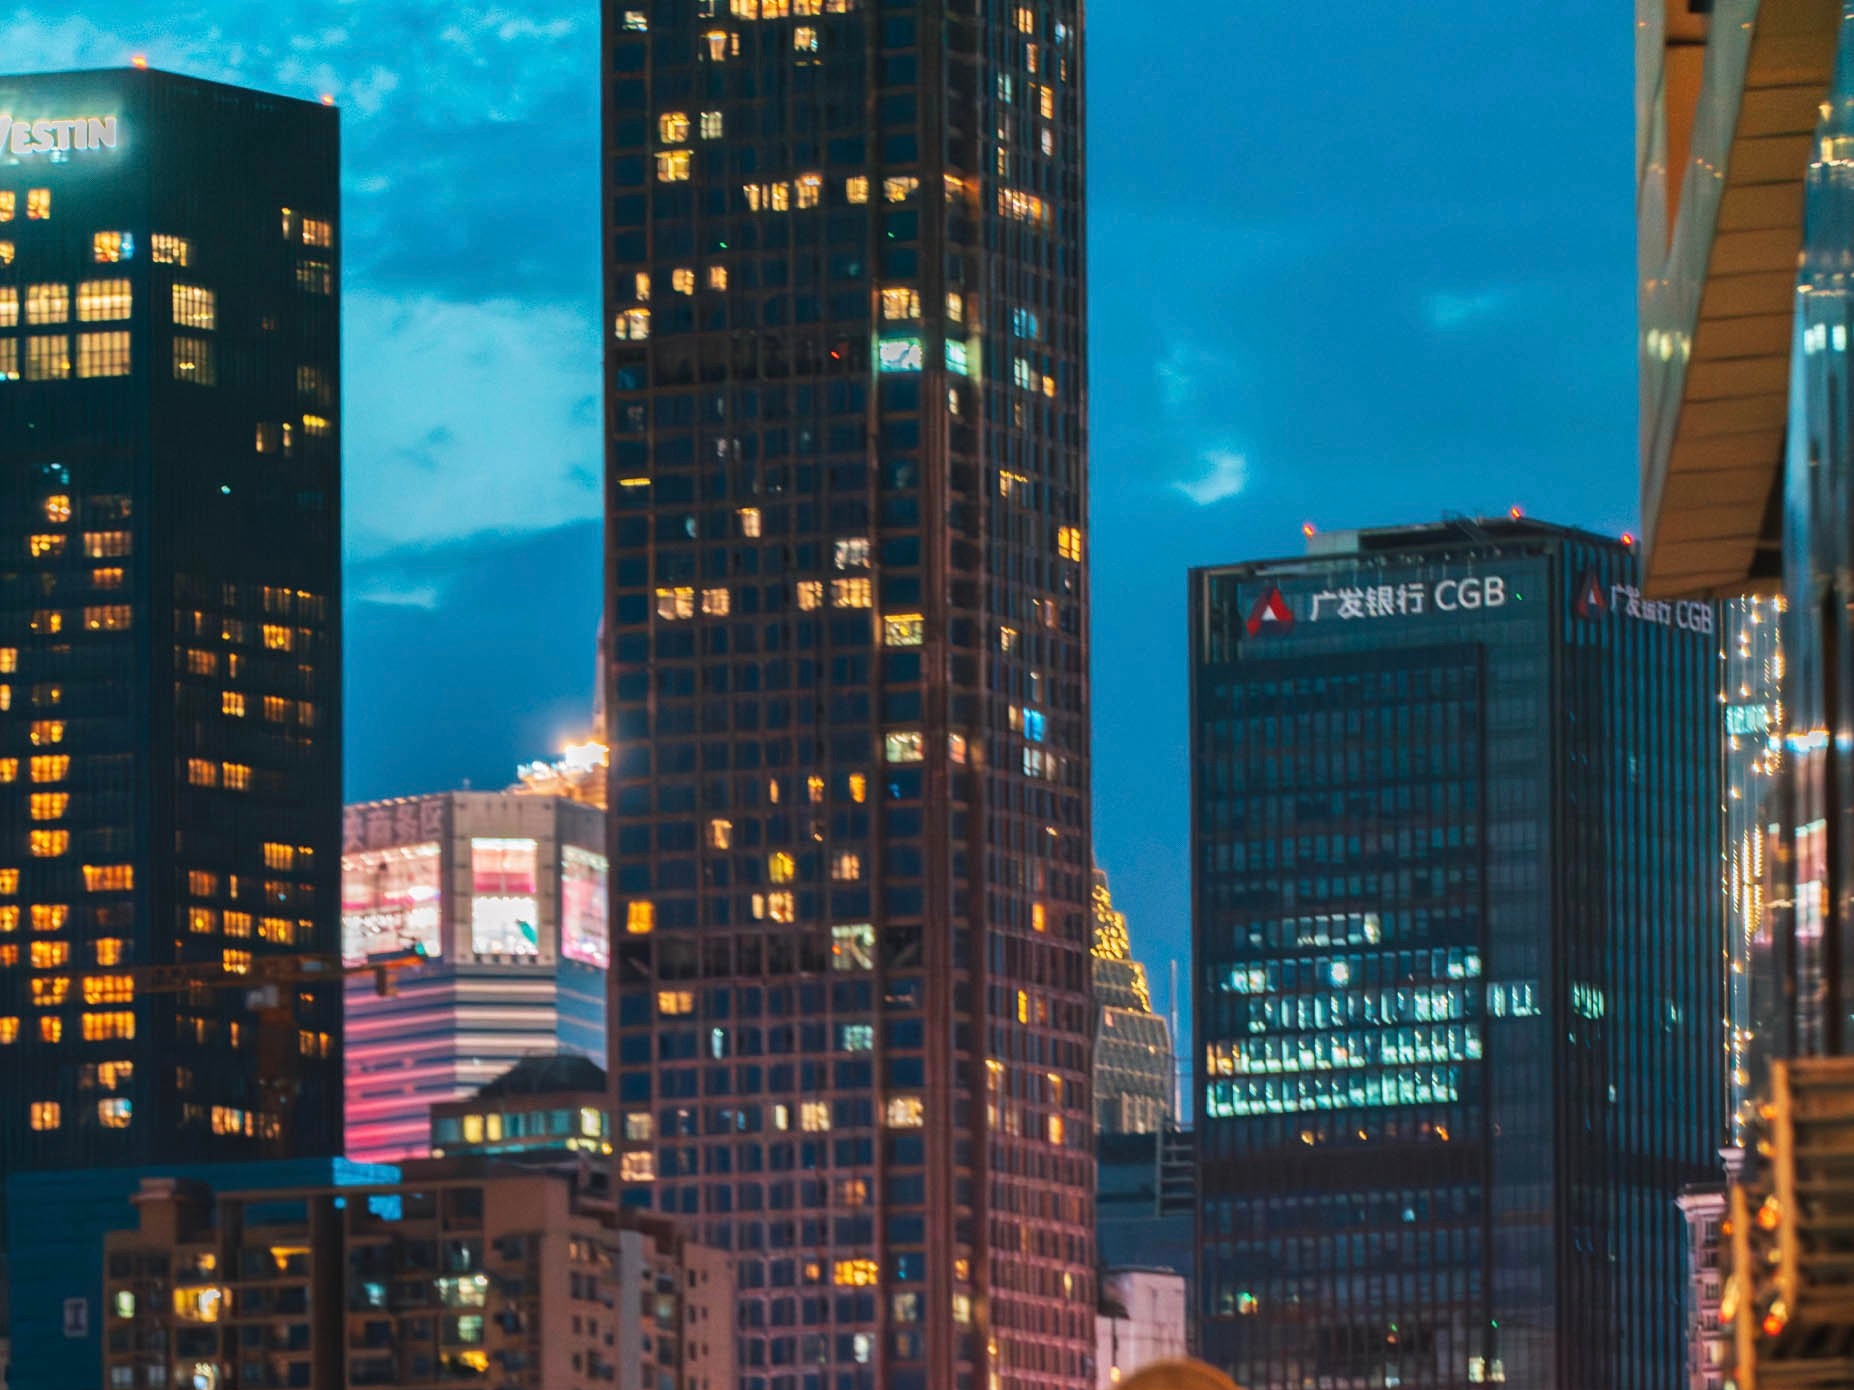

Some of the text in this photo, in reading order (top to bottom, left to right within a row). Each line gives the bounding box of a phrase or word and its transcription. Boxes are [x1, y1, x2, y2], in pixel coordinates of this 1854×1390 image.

[1310, 576, 1505, 622] 广发银行 CGB
[1676, 600, 1713, 634] CGB
